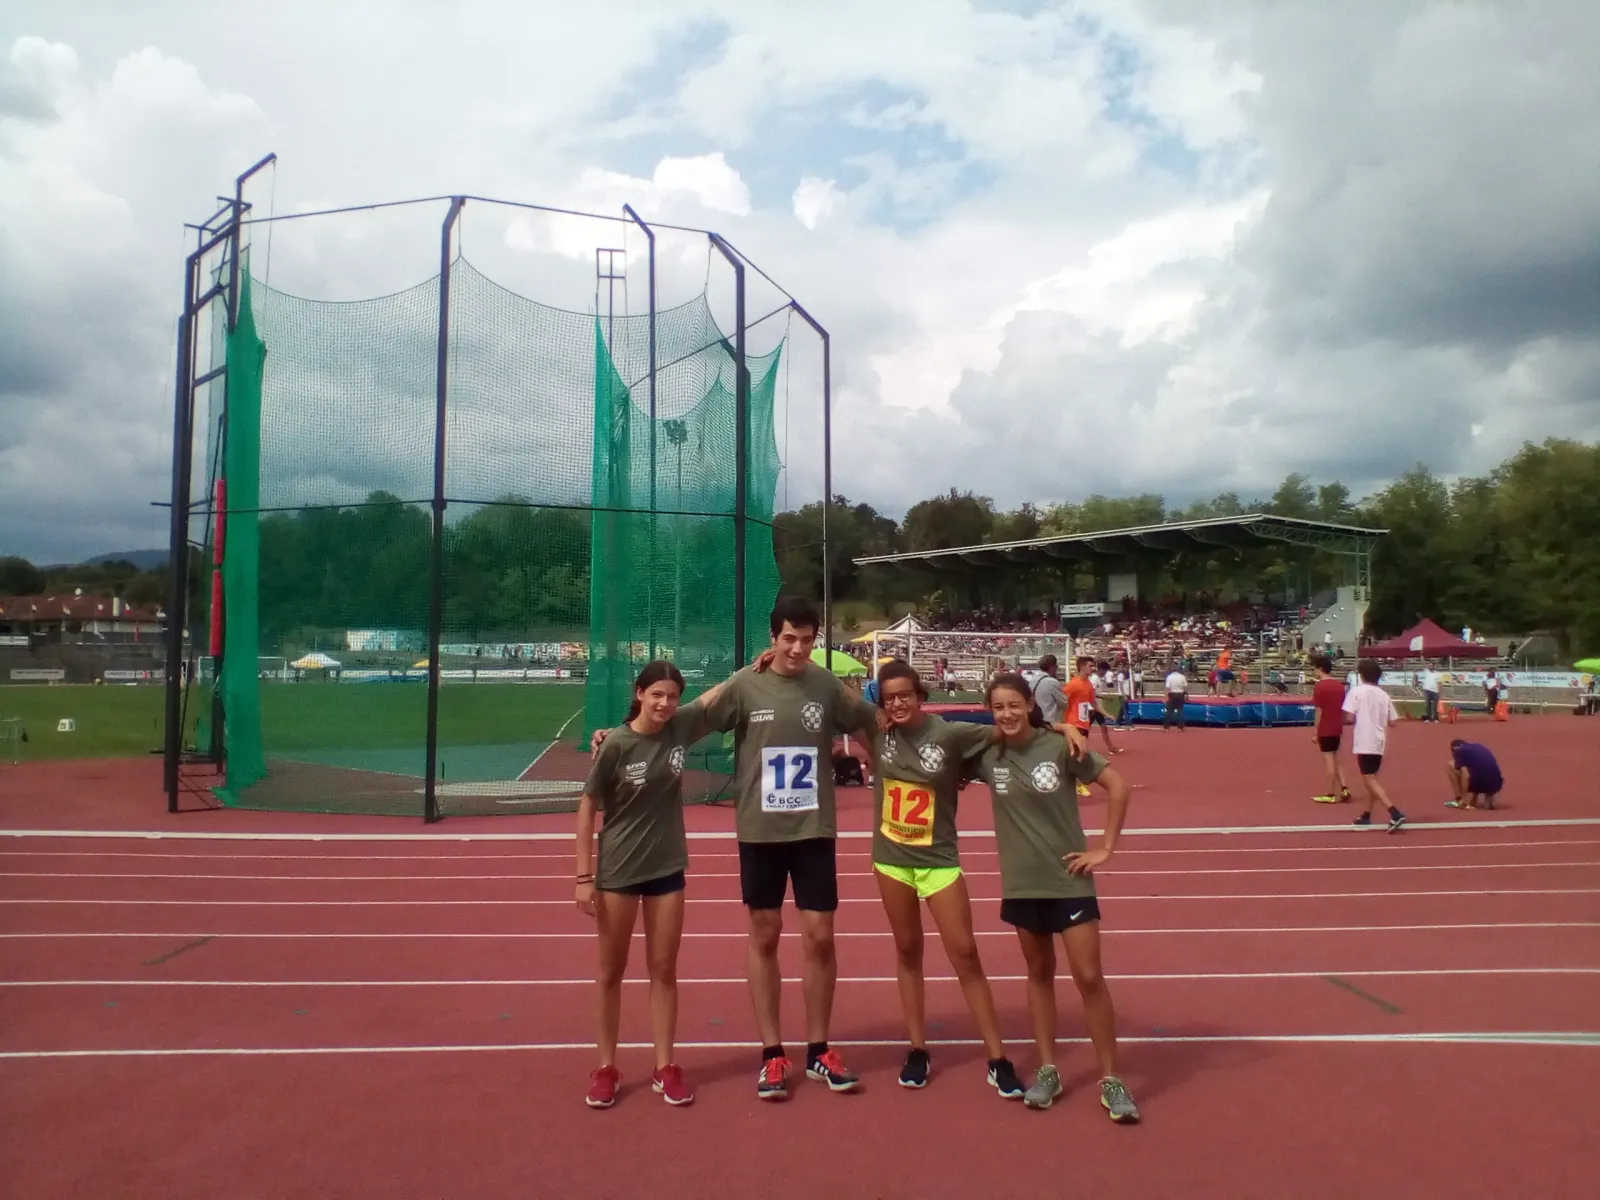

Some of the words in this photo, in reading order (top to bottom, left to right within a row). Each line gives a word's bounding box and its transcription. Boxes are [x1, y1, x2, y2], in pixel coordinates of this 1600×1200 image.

[768, 753, 813, 790] 12
[779, 796, 801, 804] BCC
[888, 786, 930, 826] 12
